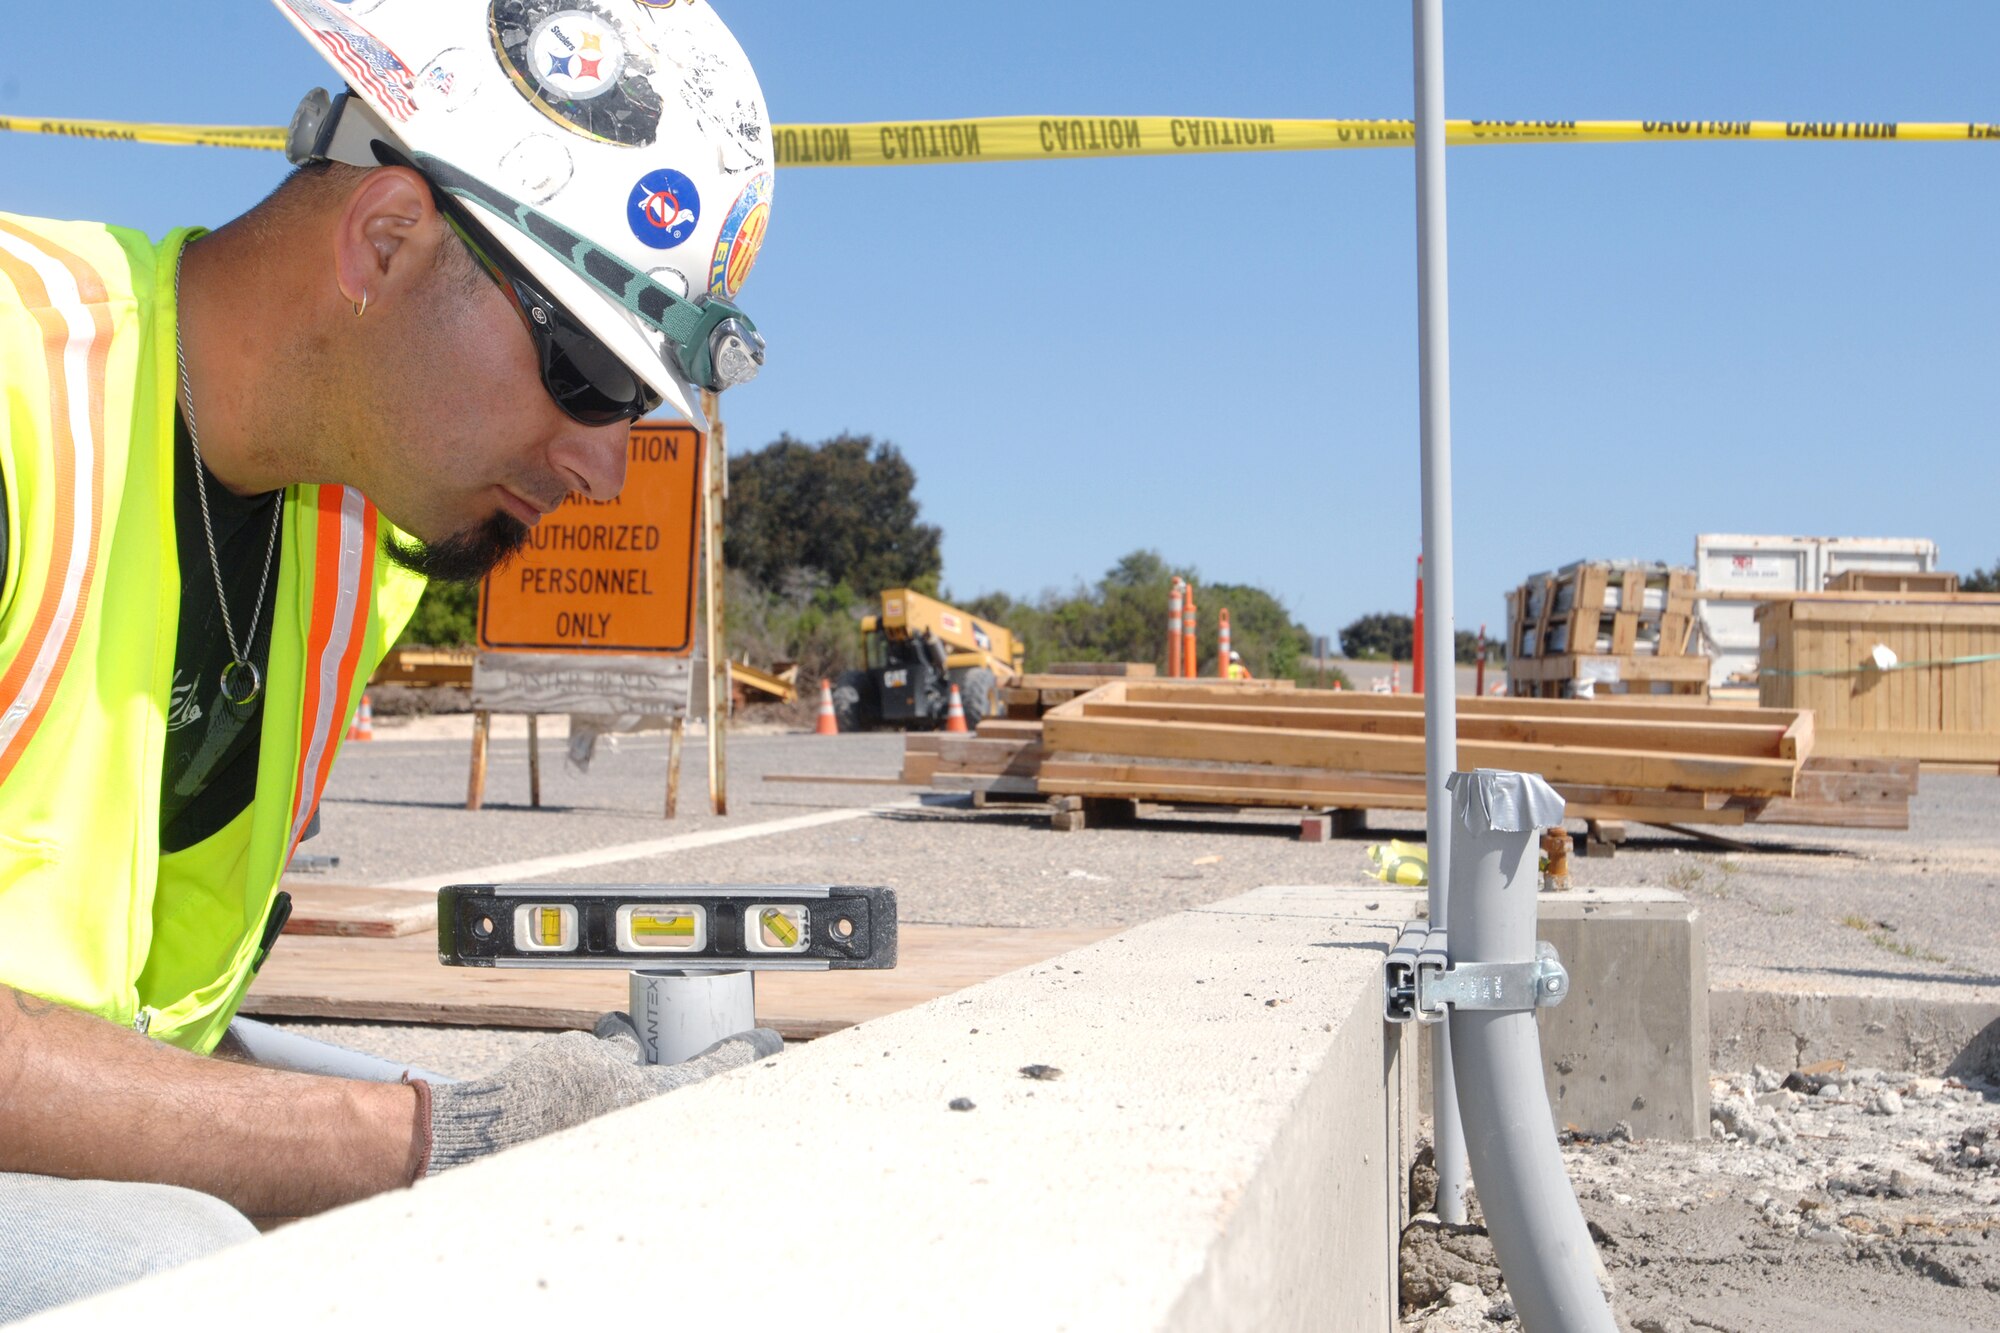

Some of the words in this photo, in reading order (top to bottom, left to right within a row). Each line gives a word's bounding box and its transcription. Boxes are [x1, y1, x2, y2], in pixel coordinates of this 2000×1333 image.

[551, 25, 576, 52] Steelers
[383, 76, 409, 103] Act
[1785, 121, 1897, 138] CAUTION
[630, 436, 678, 462] TION
[520, 568, 653, 595] PERSONNEL
[556, 612, 612, 638] ONLY
[647, 977, 659, 1065] CANTEX
